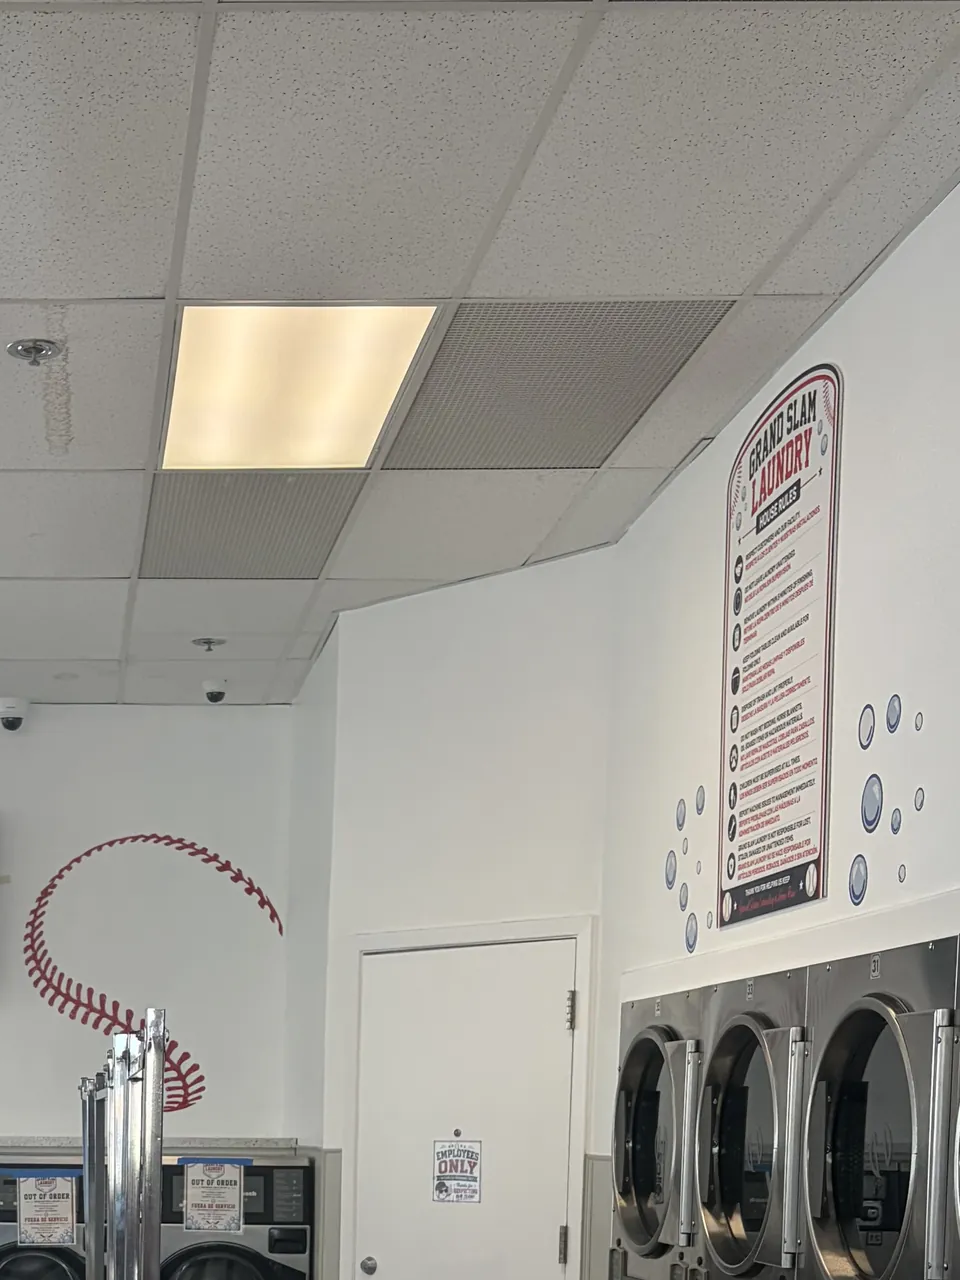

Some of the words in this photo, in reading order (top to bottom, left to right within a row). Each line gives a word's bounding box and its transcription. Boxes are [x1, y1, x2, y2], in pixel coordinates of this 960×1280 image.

[749, 411, 784, 481] GRAND
[786, 389, 817, 435] SLAM
[751, 427, 813, 517] LAUNDRY
[758, 502, 780, 529] HOUSE
[777, 485, 798, 514] RULES
[436, 1149, 479, 1161] EMPLOYEES
[438, 1159, 478, 1175] ONLY
[216, 1179, 238, 1187] ORDER
